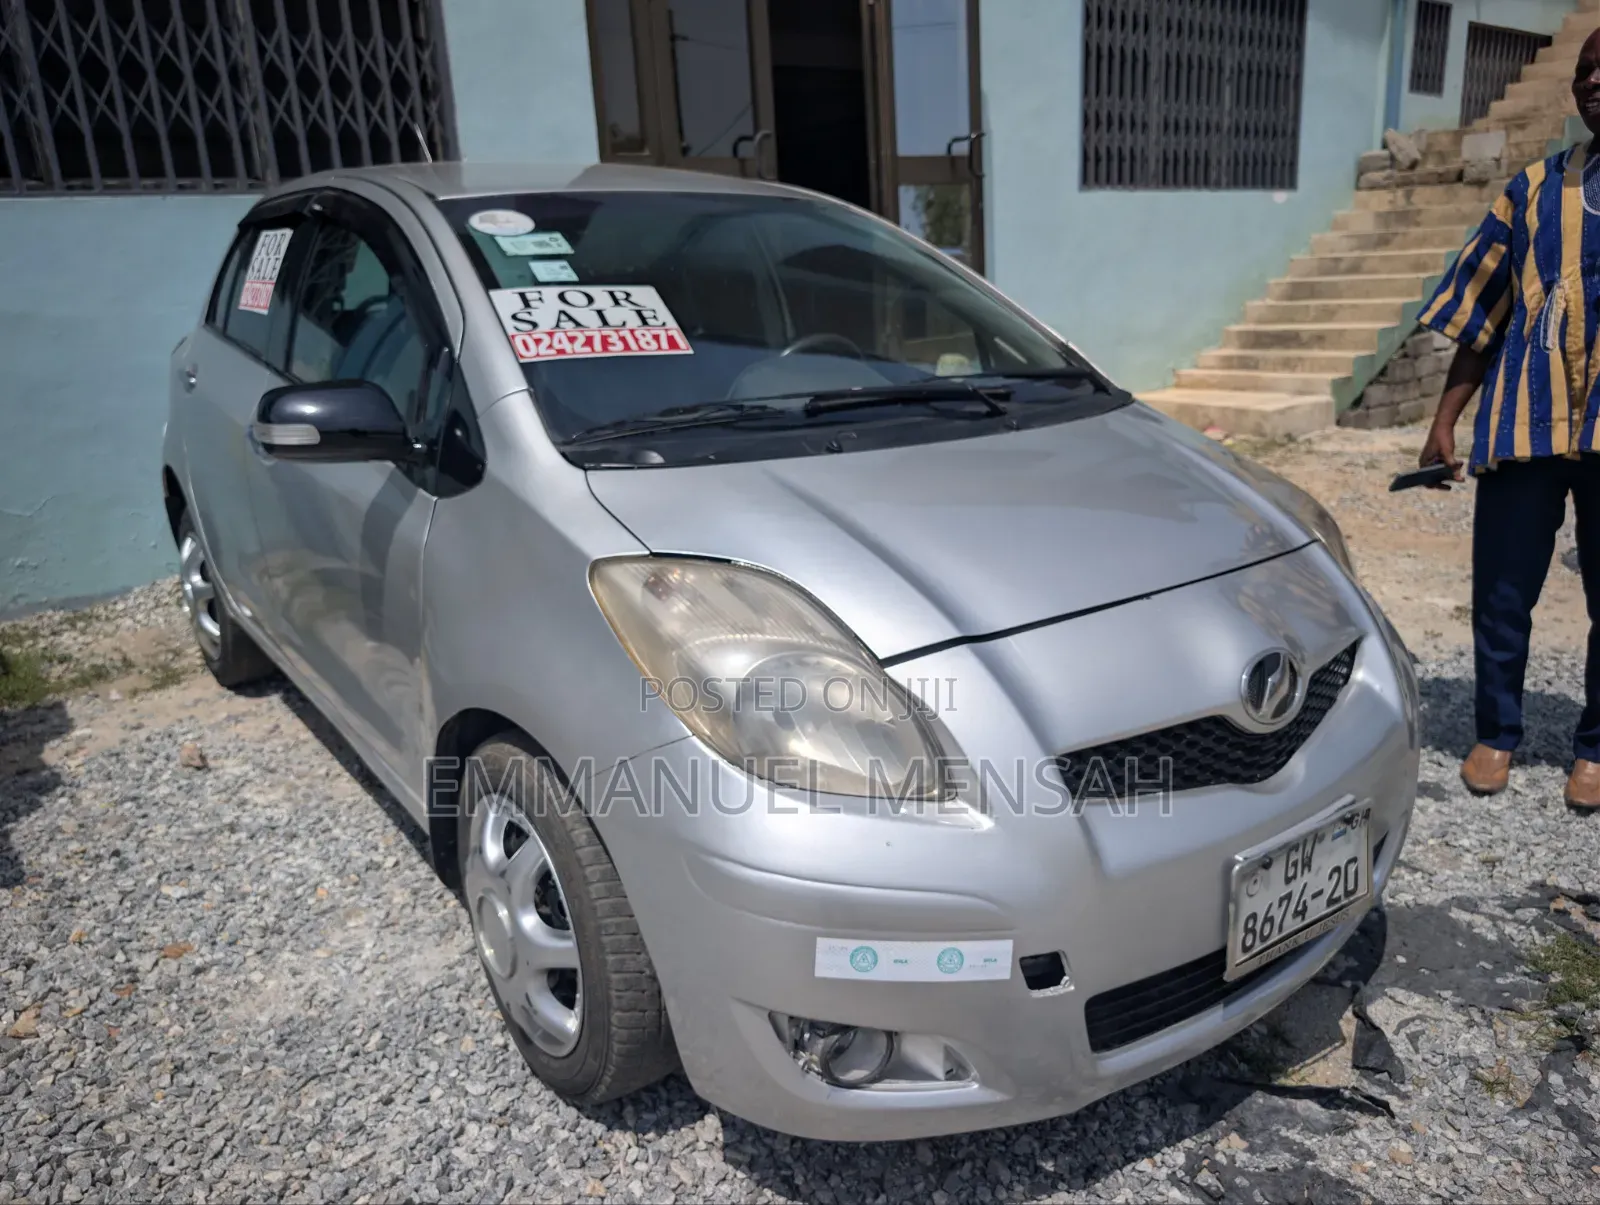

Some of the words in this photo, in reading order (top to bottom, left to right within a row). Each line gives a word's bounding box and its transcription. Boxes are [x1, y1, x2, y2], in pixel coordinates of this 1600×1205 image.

[258, 233, 286, 256] FOR
[248, 257, 280, 280] SALE
[512, 289, 647, 311] FOR
[510, 308, 667, 333] SALE
[513, 328, 688, 358] 0242731871
[1283, 832, 1319, 885] GW
[1241, 856, 1359, 954] 8674-20
